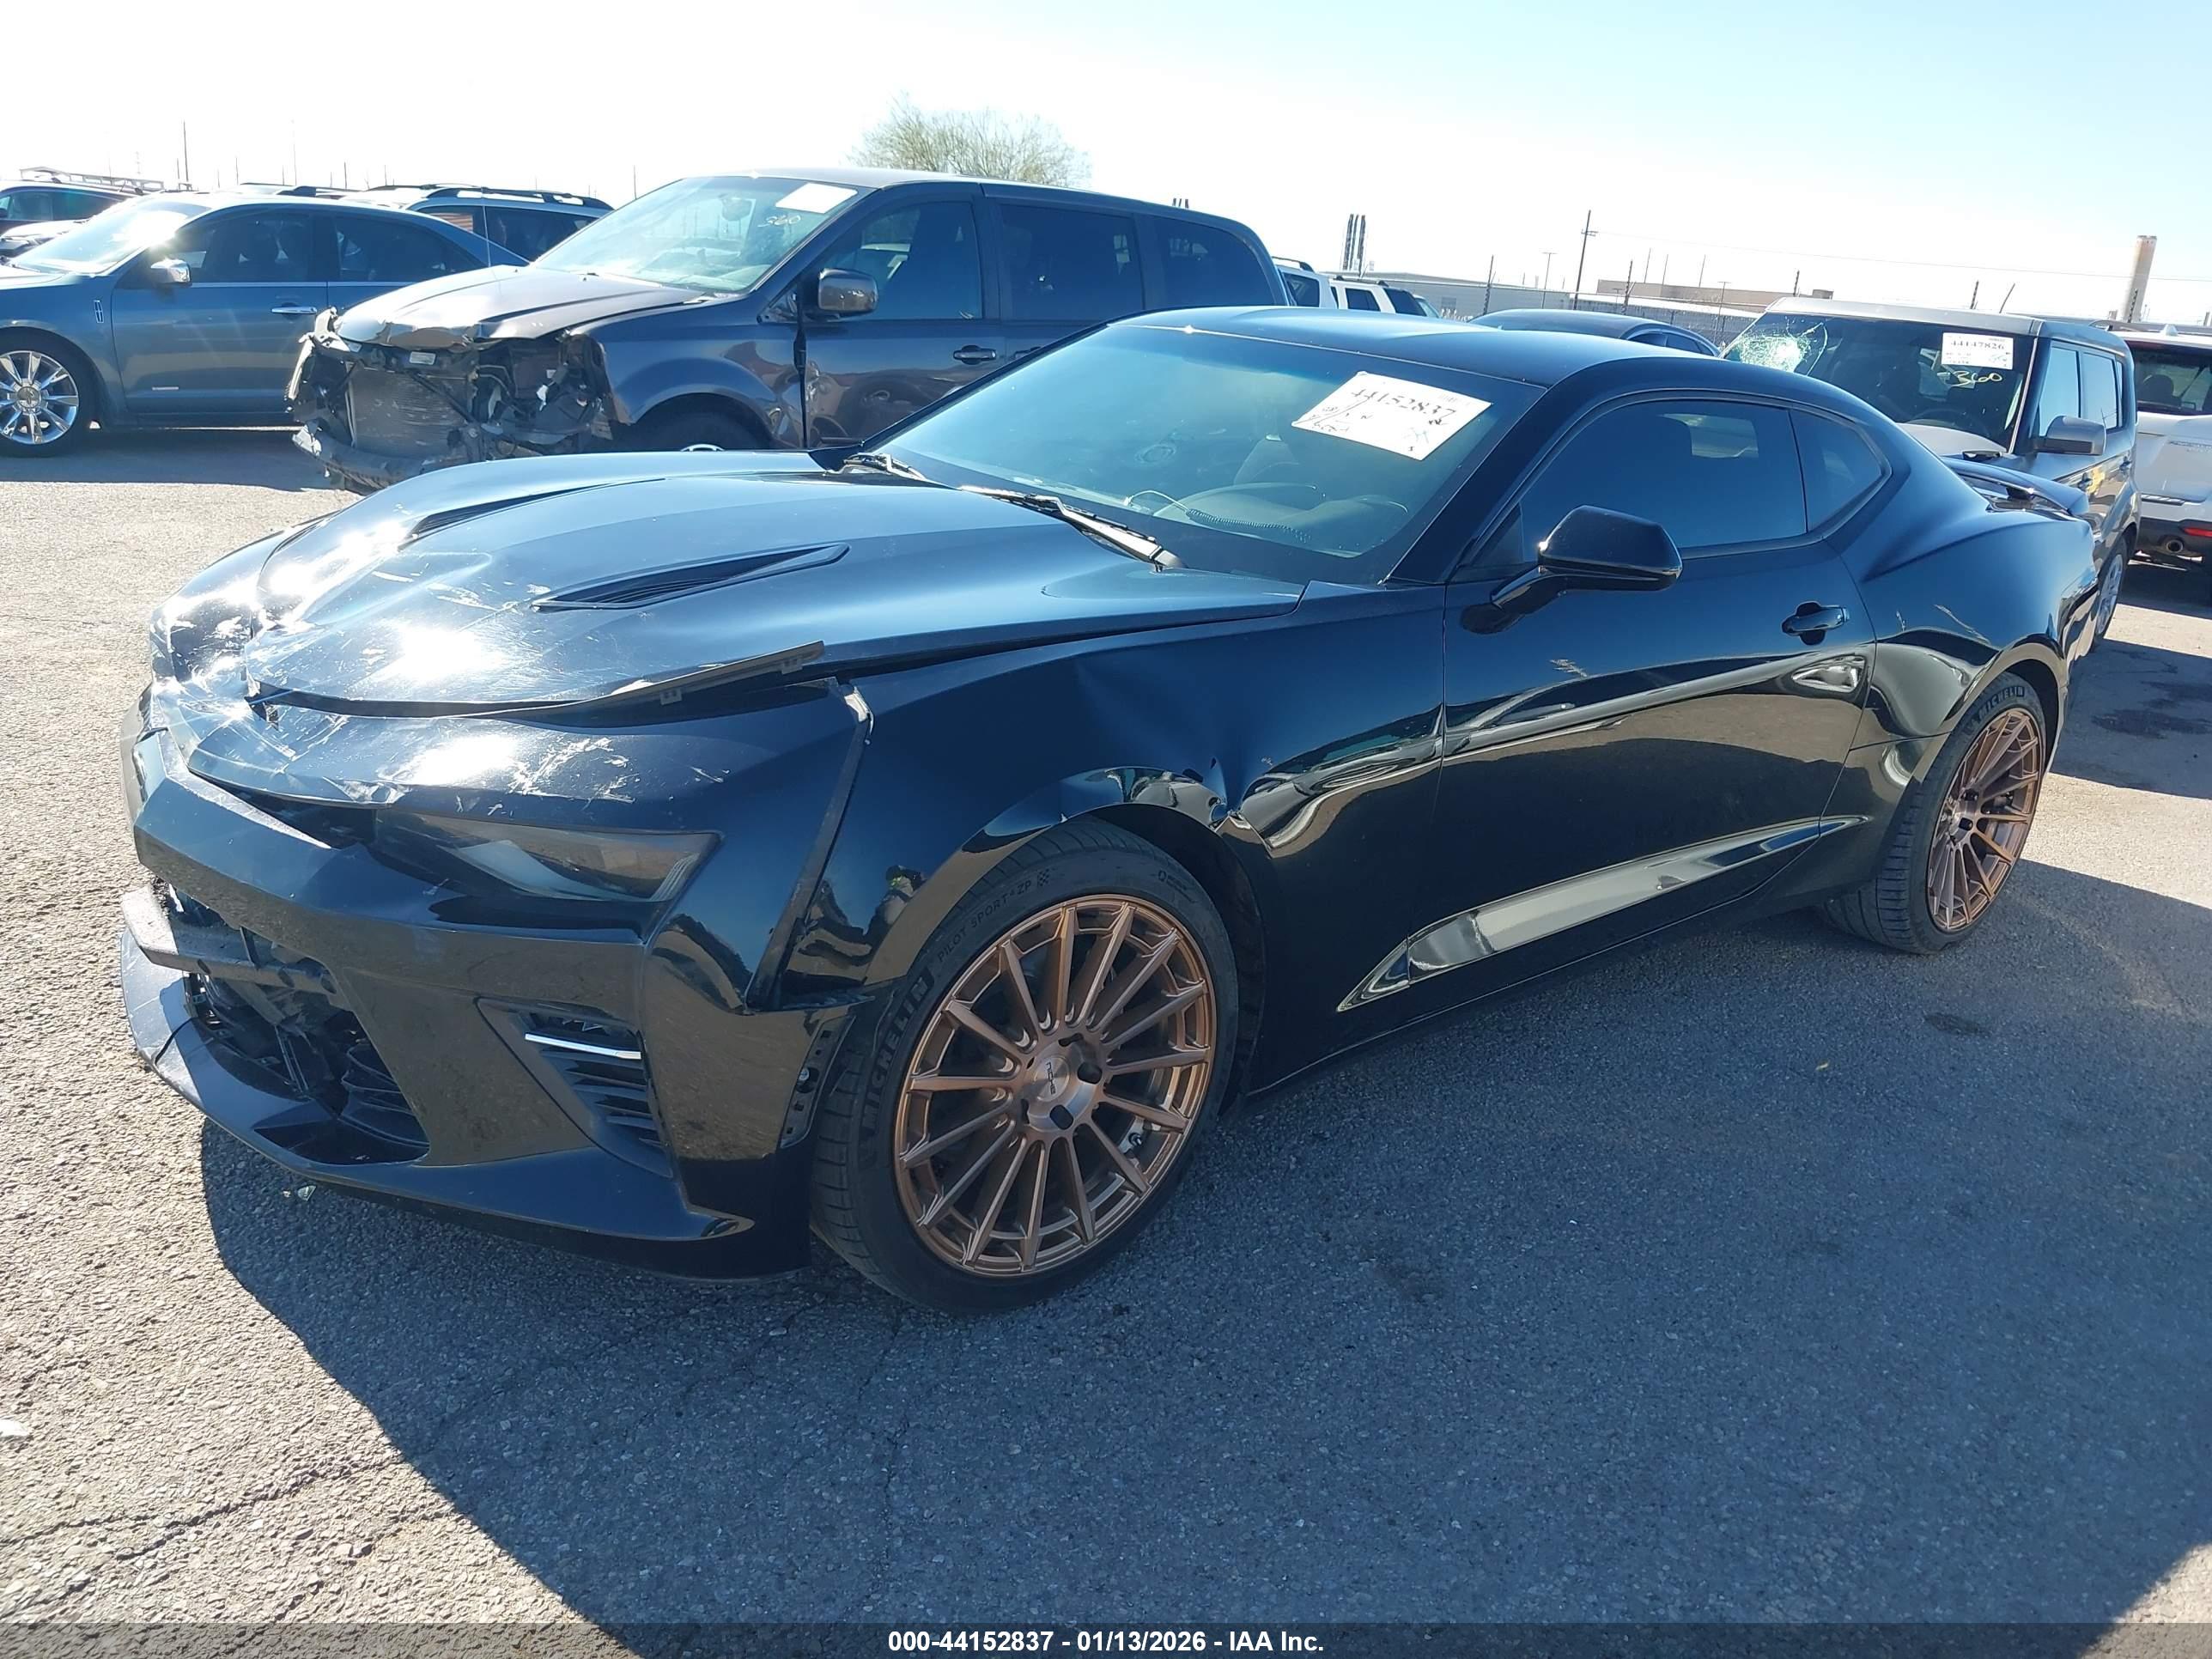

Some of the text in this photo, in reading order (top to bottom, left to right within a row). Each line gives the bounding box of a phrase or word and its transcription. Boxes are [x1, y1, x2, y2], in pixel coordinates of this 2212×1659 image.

[1951, 339, 2005, 350] 44147826
[1351, 388, 1457, 419] 44152837
[1978, 686, 2026, 720] MICHELIN
[861, 975, 930, 1131] MICHELIN
[936, 927, 969, 963] PILOT
[1017, 879, 1032, 896] ZP
